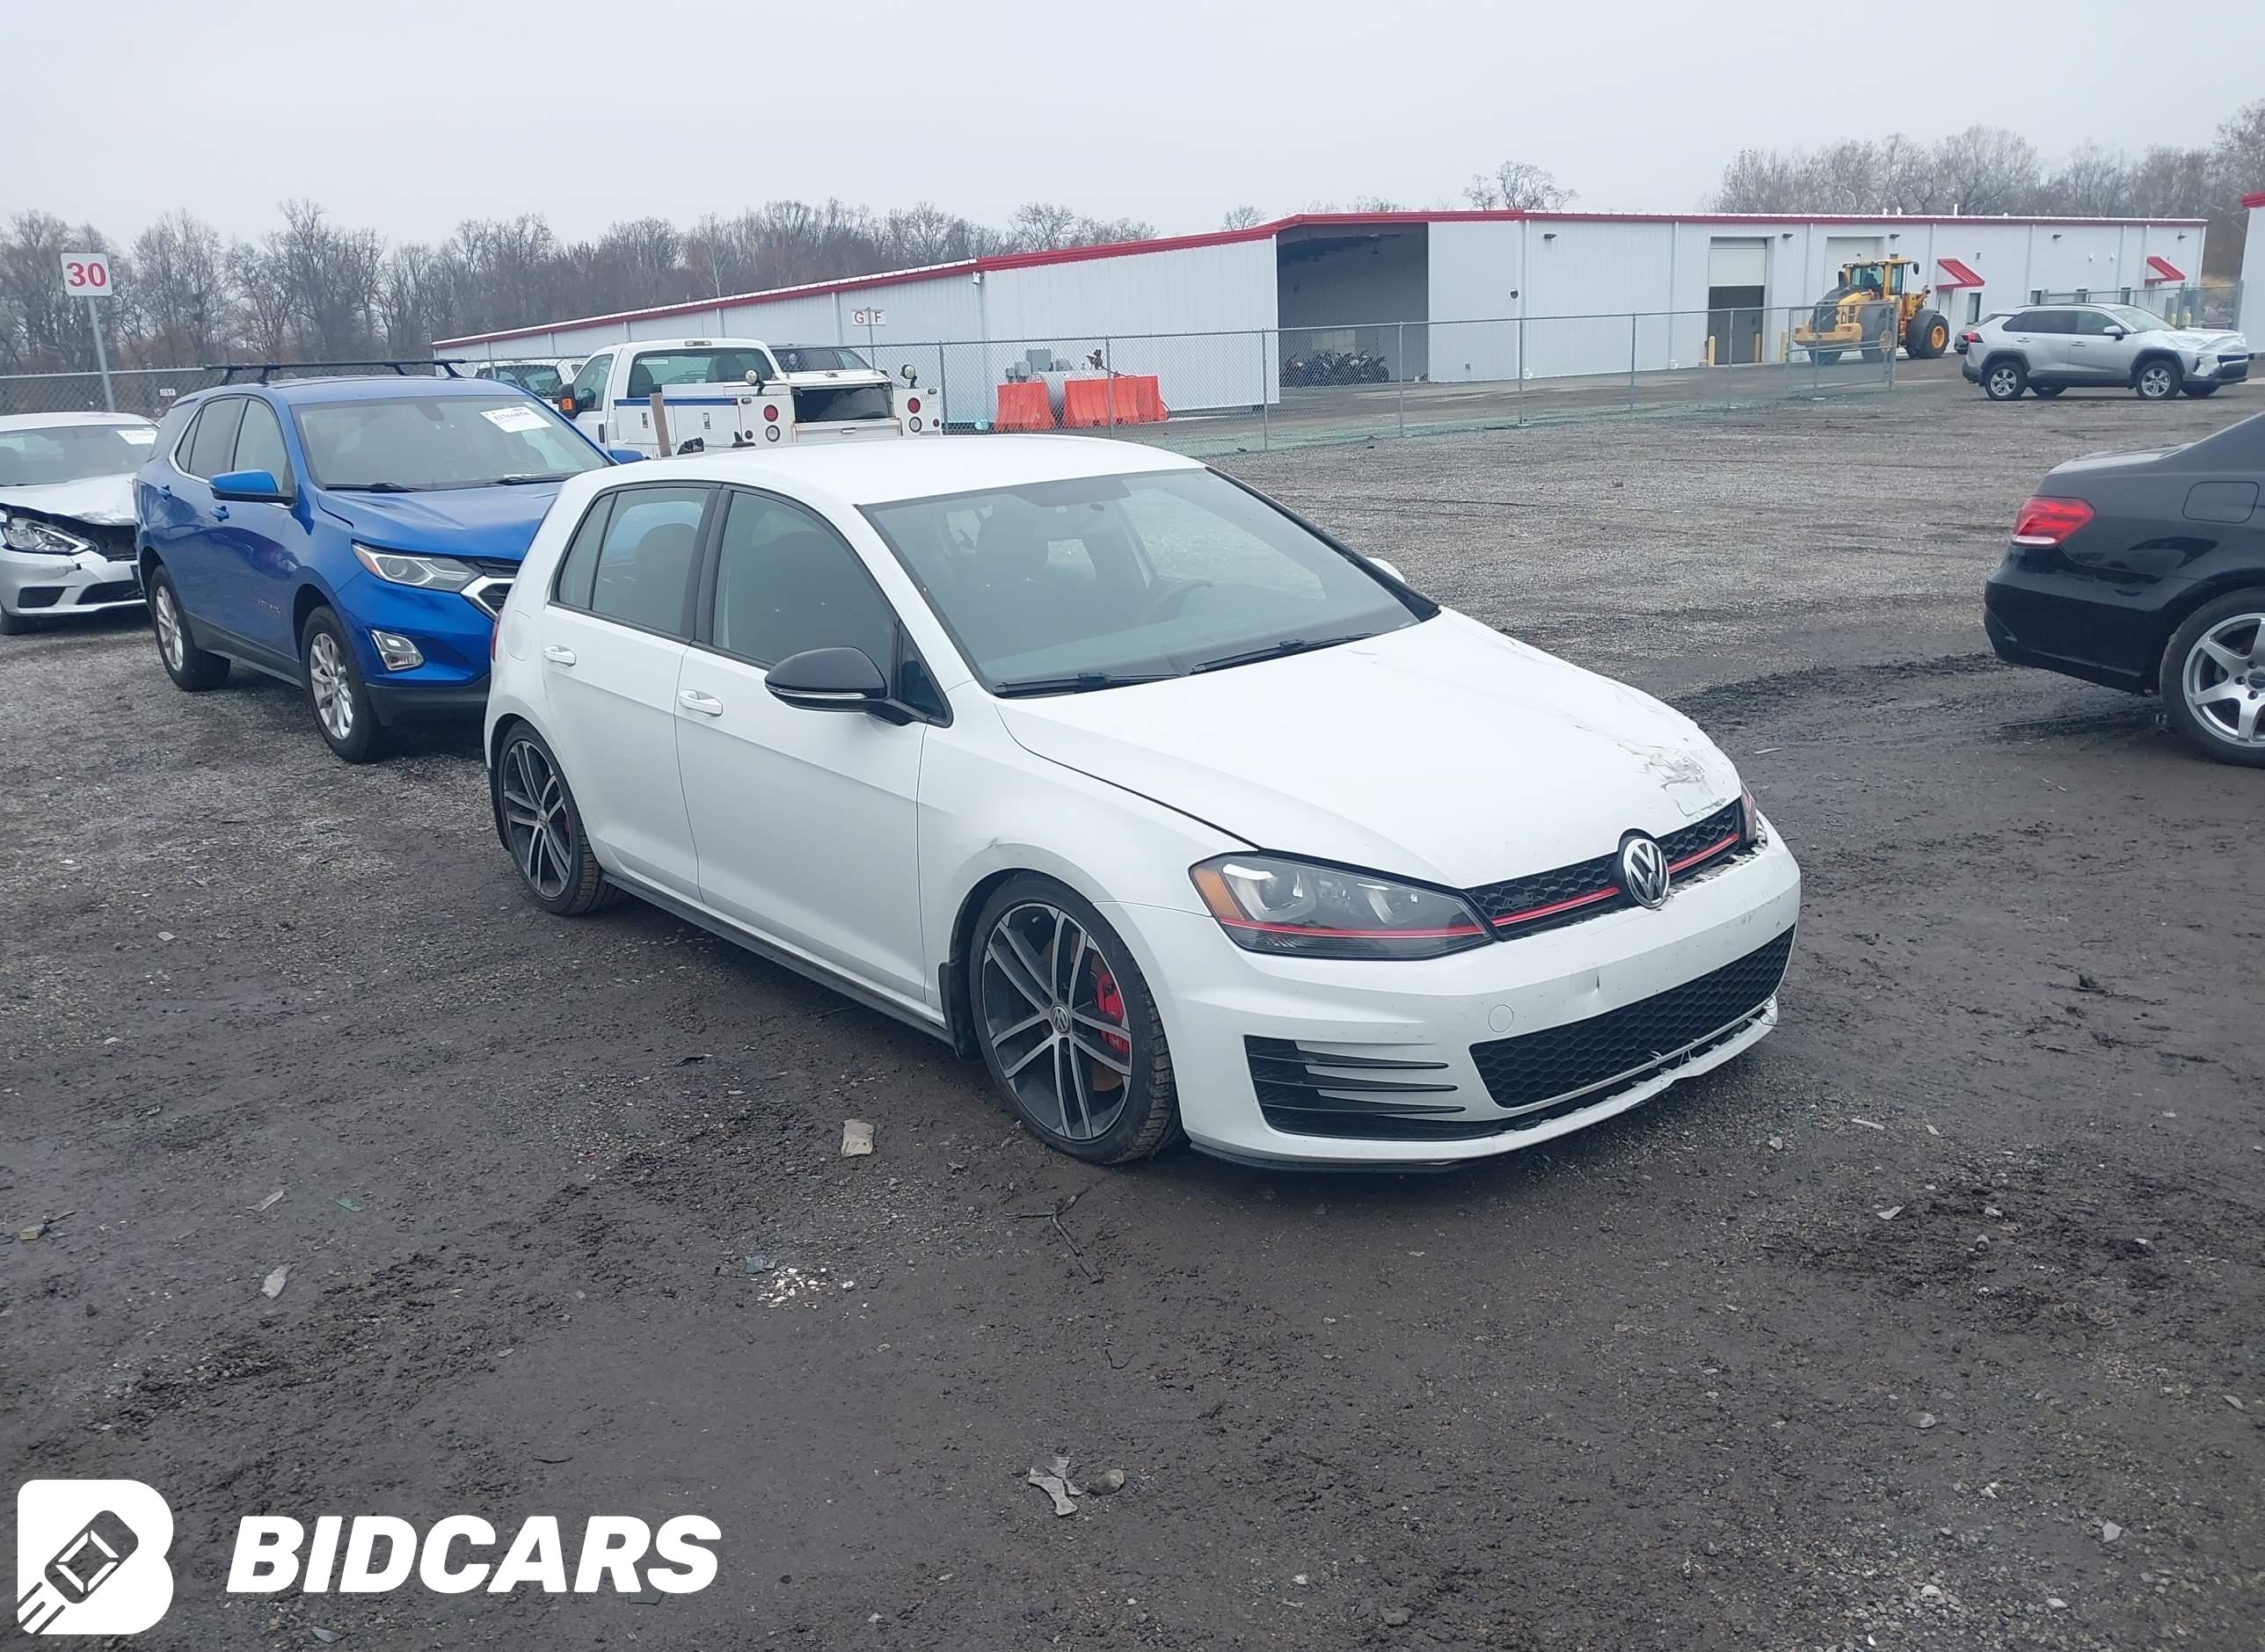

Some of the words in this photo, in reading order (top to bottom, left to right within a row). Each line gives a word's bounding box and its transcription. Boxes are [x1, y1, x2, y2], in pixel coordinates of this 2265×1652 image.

[66, 262, 106, 287] 30
[854, 310, 865, 324] G
[874, 311, 882, 324] F
[1624, 839, 1669, 906] VW
